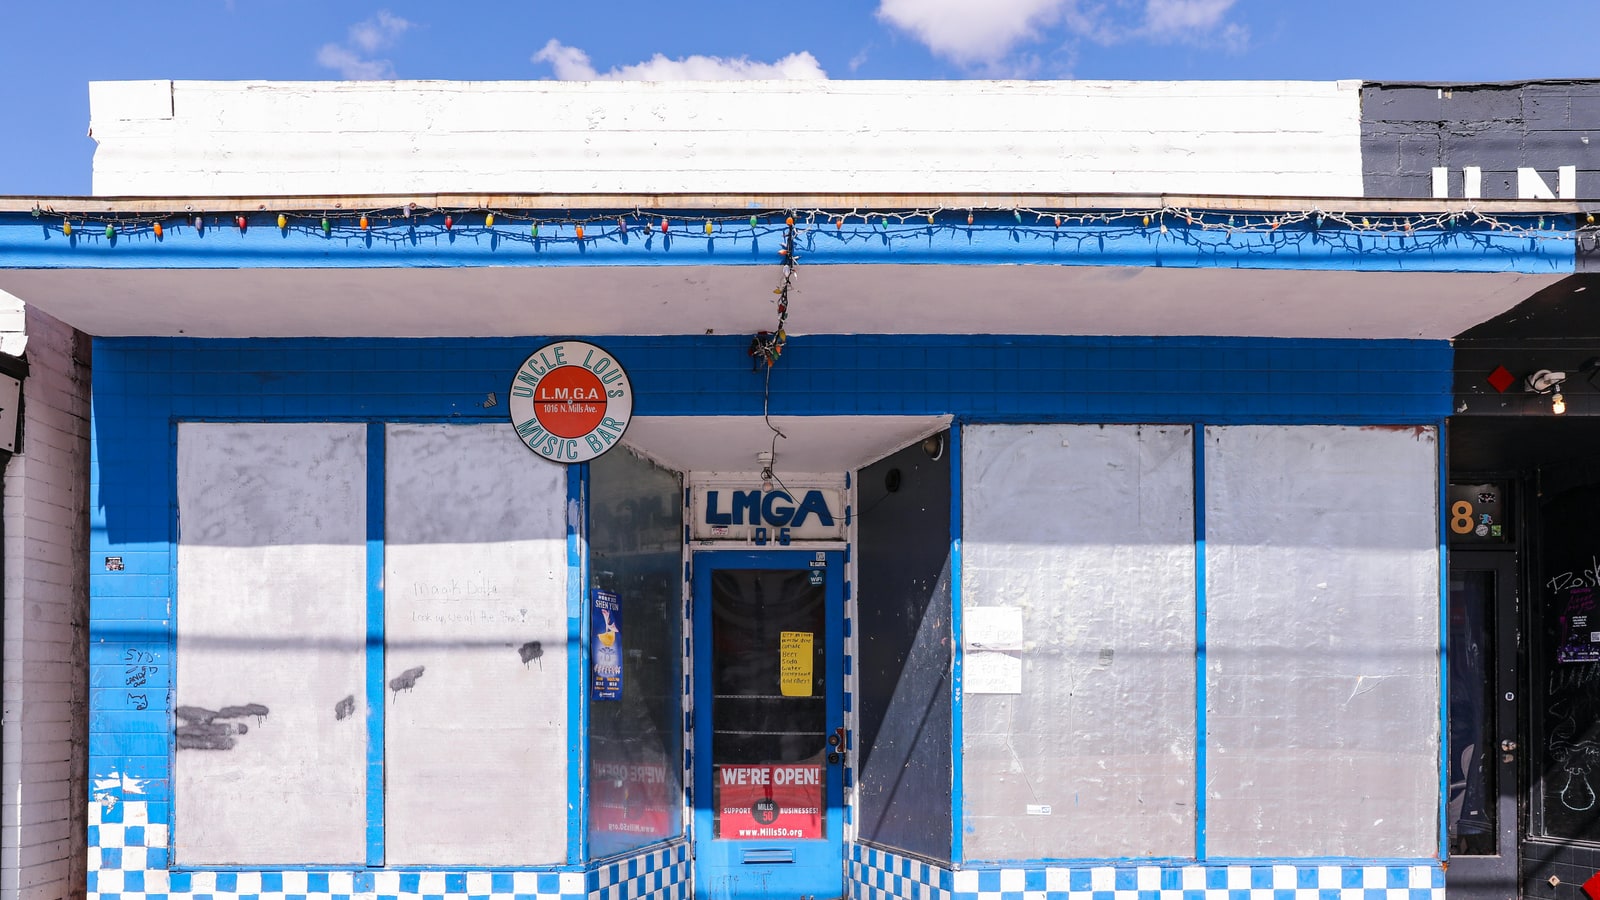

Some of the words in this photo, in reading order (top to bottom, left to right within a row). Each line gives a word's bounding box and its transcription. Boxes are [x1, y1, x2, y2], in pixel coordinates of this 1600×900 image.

[512, 346, 567, 398] UNCLE
[583, 349, 625, 398] LOU'S
[541, 387, 599, 399] L.M.G.A
[544, 405, 558, 413] 1016
[560, 405, 568, 413] N.
[568, 404, 583, 413] Mills
[584, 405, 598, 413] Ave.
[516, 417, 578, 460] MUSIC
[584, 416, 625, 454] BAR
[706, 490, 835, 527] LMGA
[1451, 500, 1474, 534] 8
[721, 768, 770, 785] WE'RE
[774, 768, 819, 785] OPEN!
[757, 803, 774, 811] MILLS
[779, 807, 819, 815] BUSINESSES!
[762, 811, 773, 821] 50
[739, 828, 803, 837] www.Mills50.org
